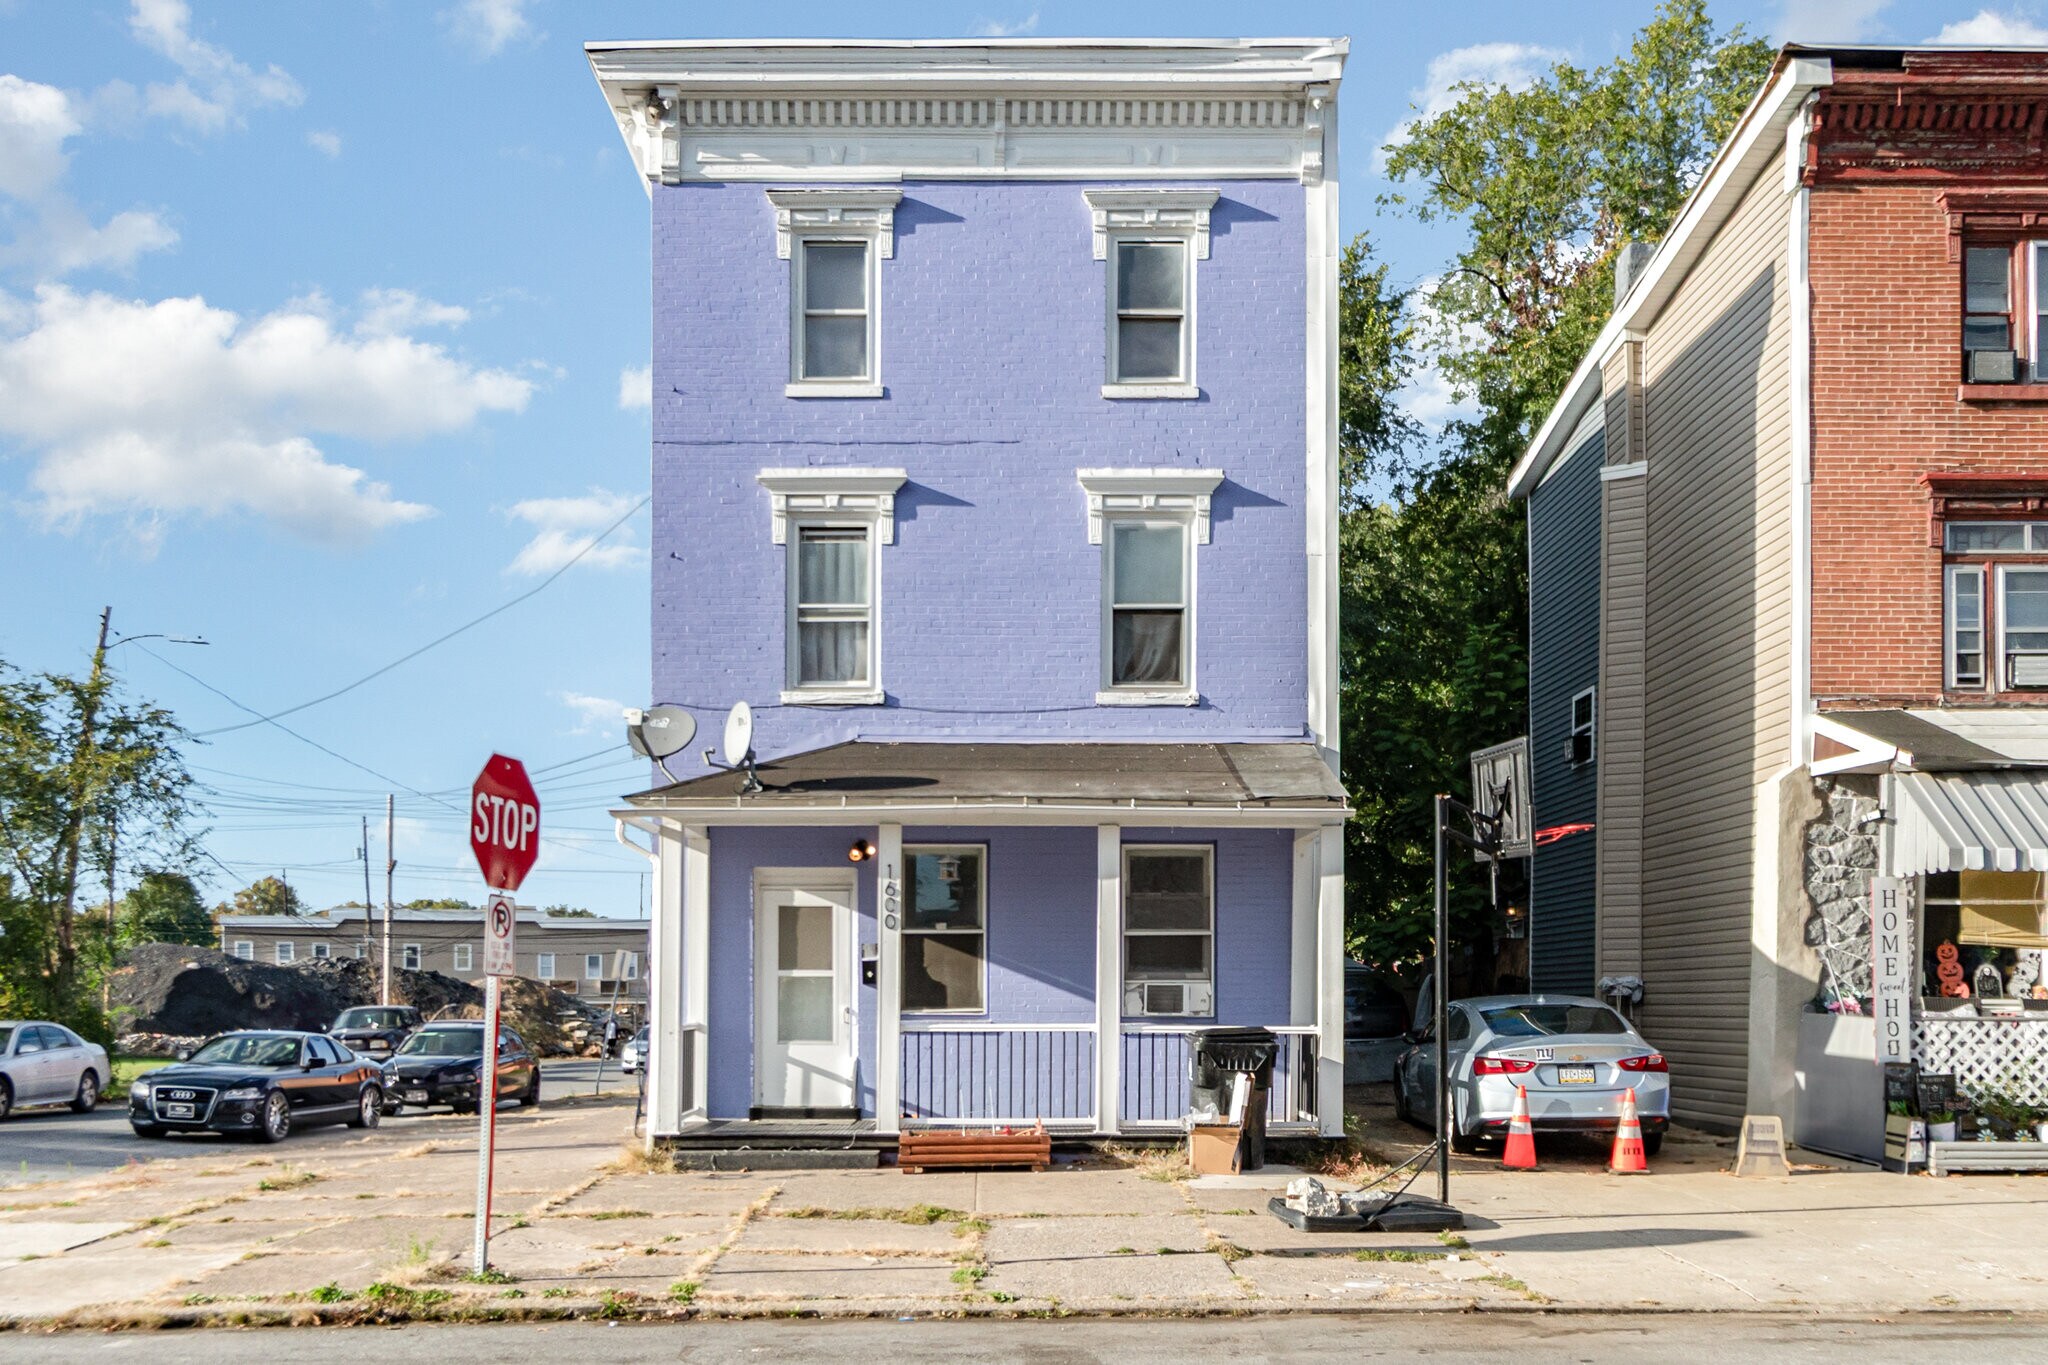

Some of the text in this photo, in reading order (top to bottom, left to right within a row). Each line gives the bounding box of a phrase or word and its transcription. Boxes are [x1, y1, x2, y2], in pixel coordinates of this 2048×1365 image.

[474, 792, 537, 851] STOP
[884, 863, 897, 930] 1600
[1882, 889, 1900, 976] HOME
[1879, 977, 1906, 996] sweet
